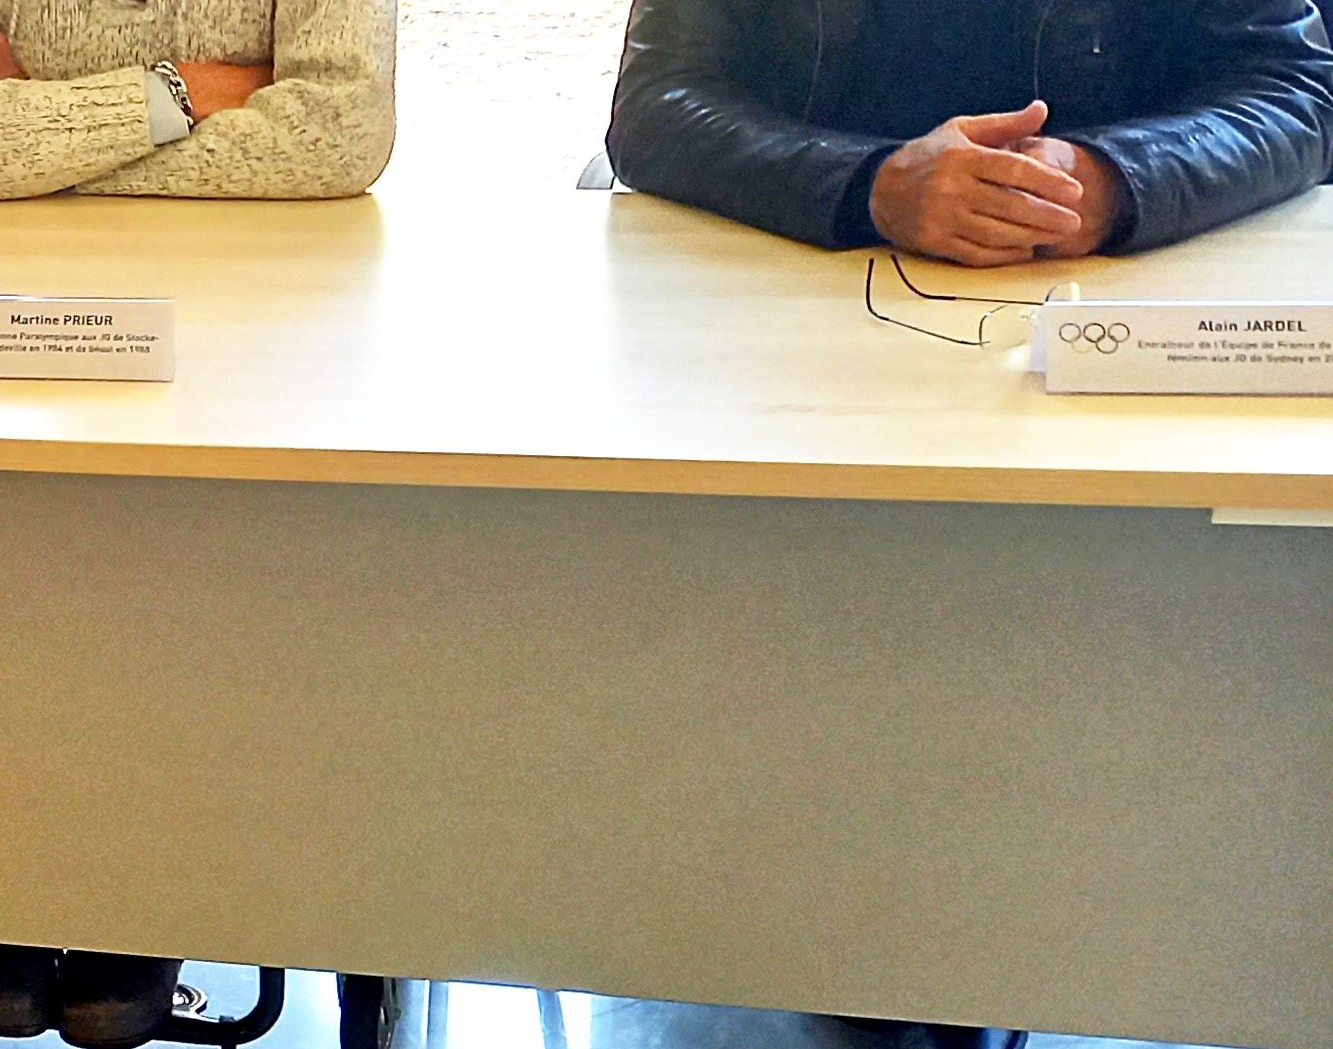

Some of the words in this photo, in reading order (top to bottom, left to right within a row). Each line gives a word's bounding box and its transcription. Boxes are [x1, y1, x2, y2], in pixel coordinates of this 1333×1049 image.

[10, 314, 59, 326] Martine
[63, 314, 113, 326] PRIEUR
[1198, 320, 1238, 333] Alain
[1243, 320, 1307, 333] JARDEL
